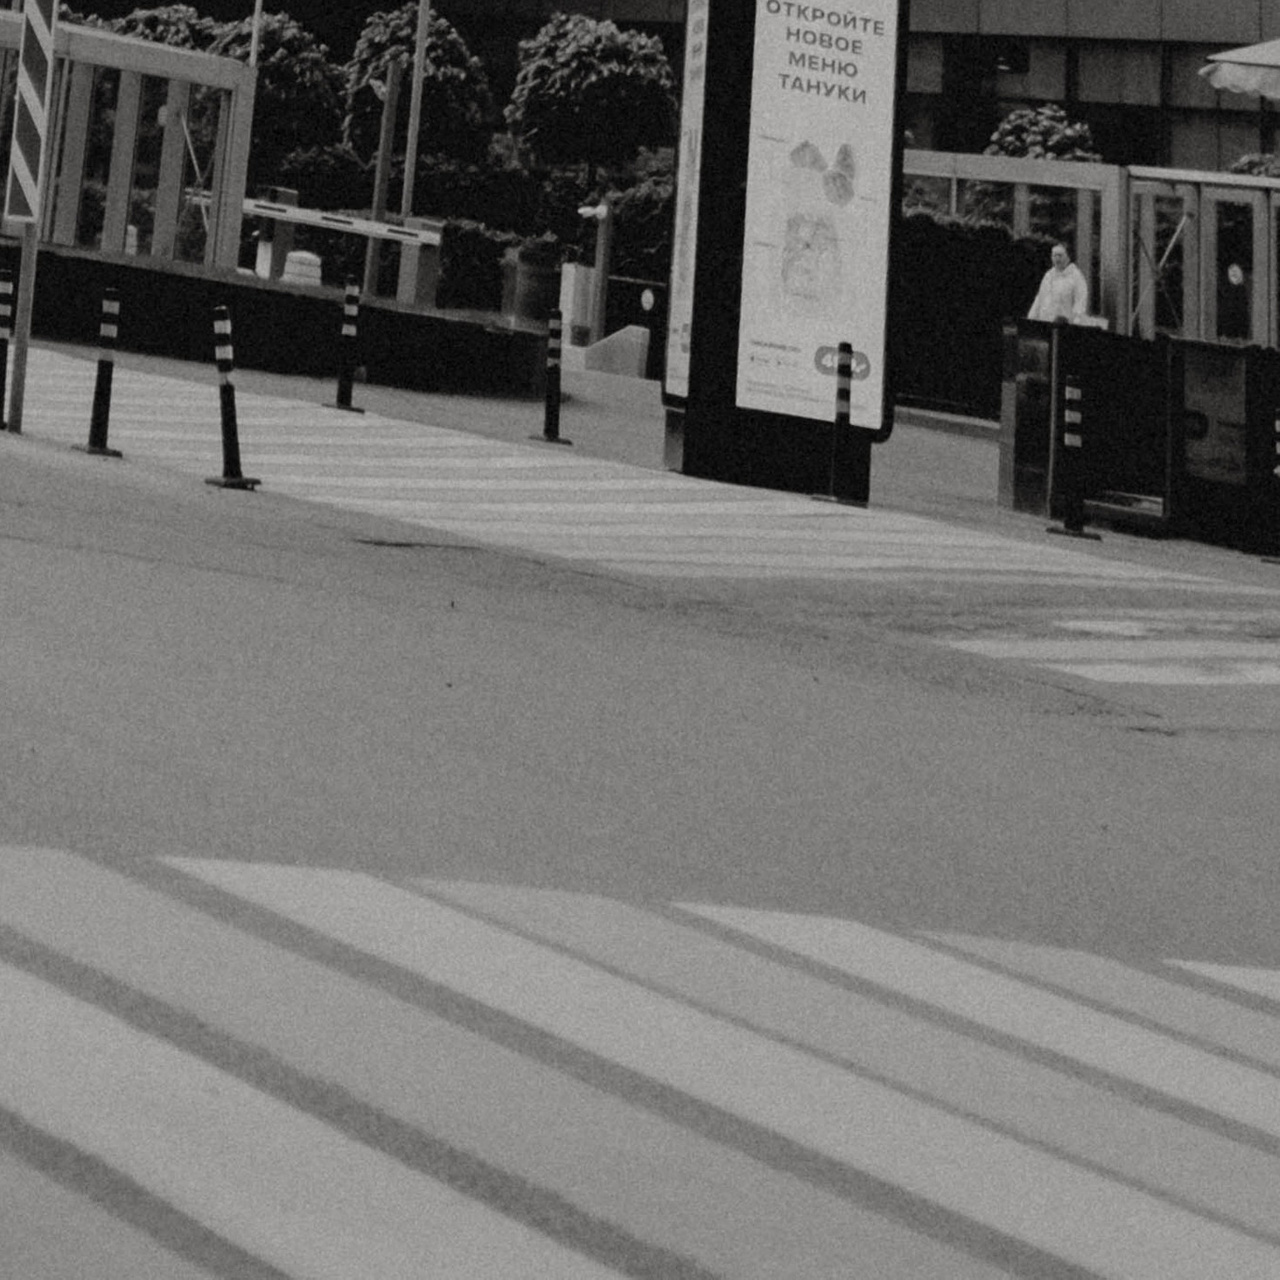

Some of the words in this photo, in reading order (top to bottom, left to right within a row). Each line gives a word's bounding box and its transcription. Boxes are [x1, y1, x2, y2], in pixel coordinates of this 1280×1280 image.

[766, 0, 885, 36] ОТКРОЙТЕ
[786, 26, 863, 55] НОВОЕ
[788, 51, 858, 77] МЕНЮ
[778, 73, 866, 104] ТАНУКИ
